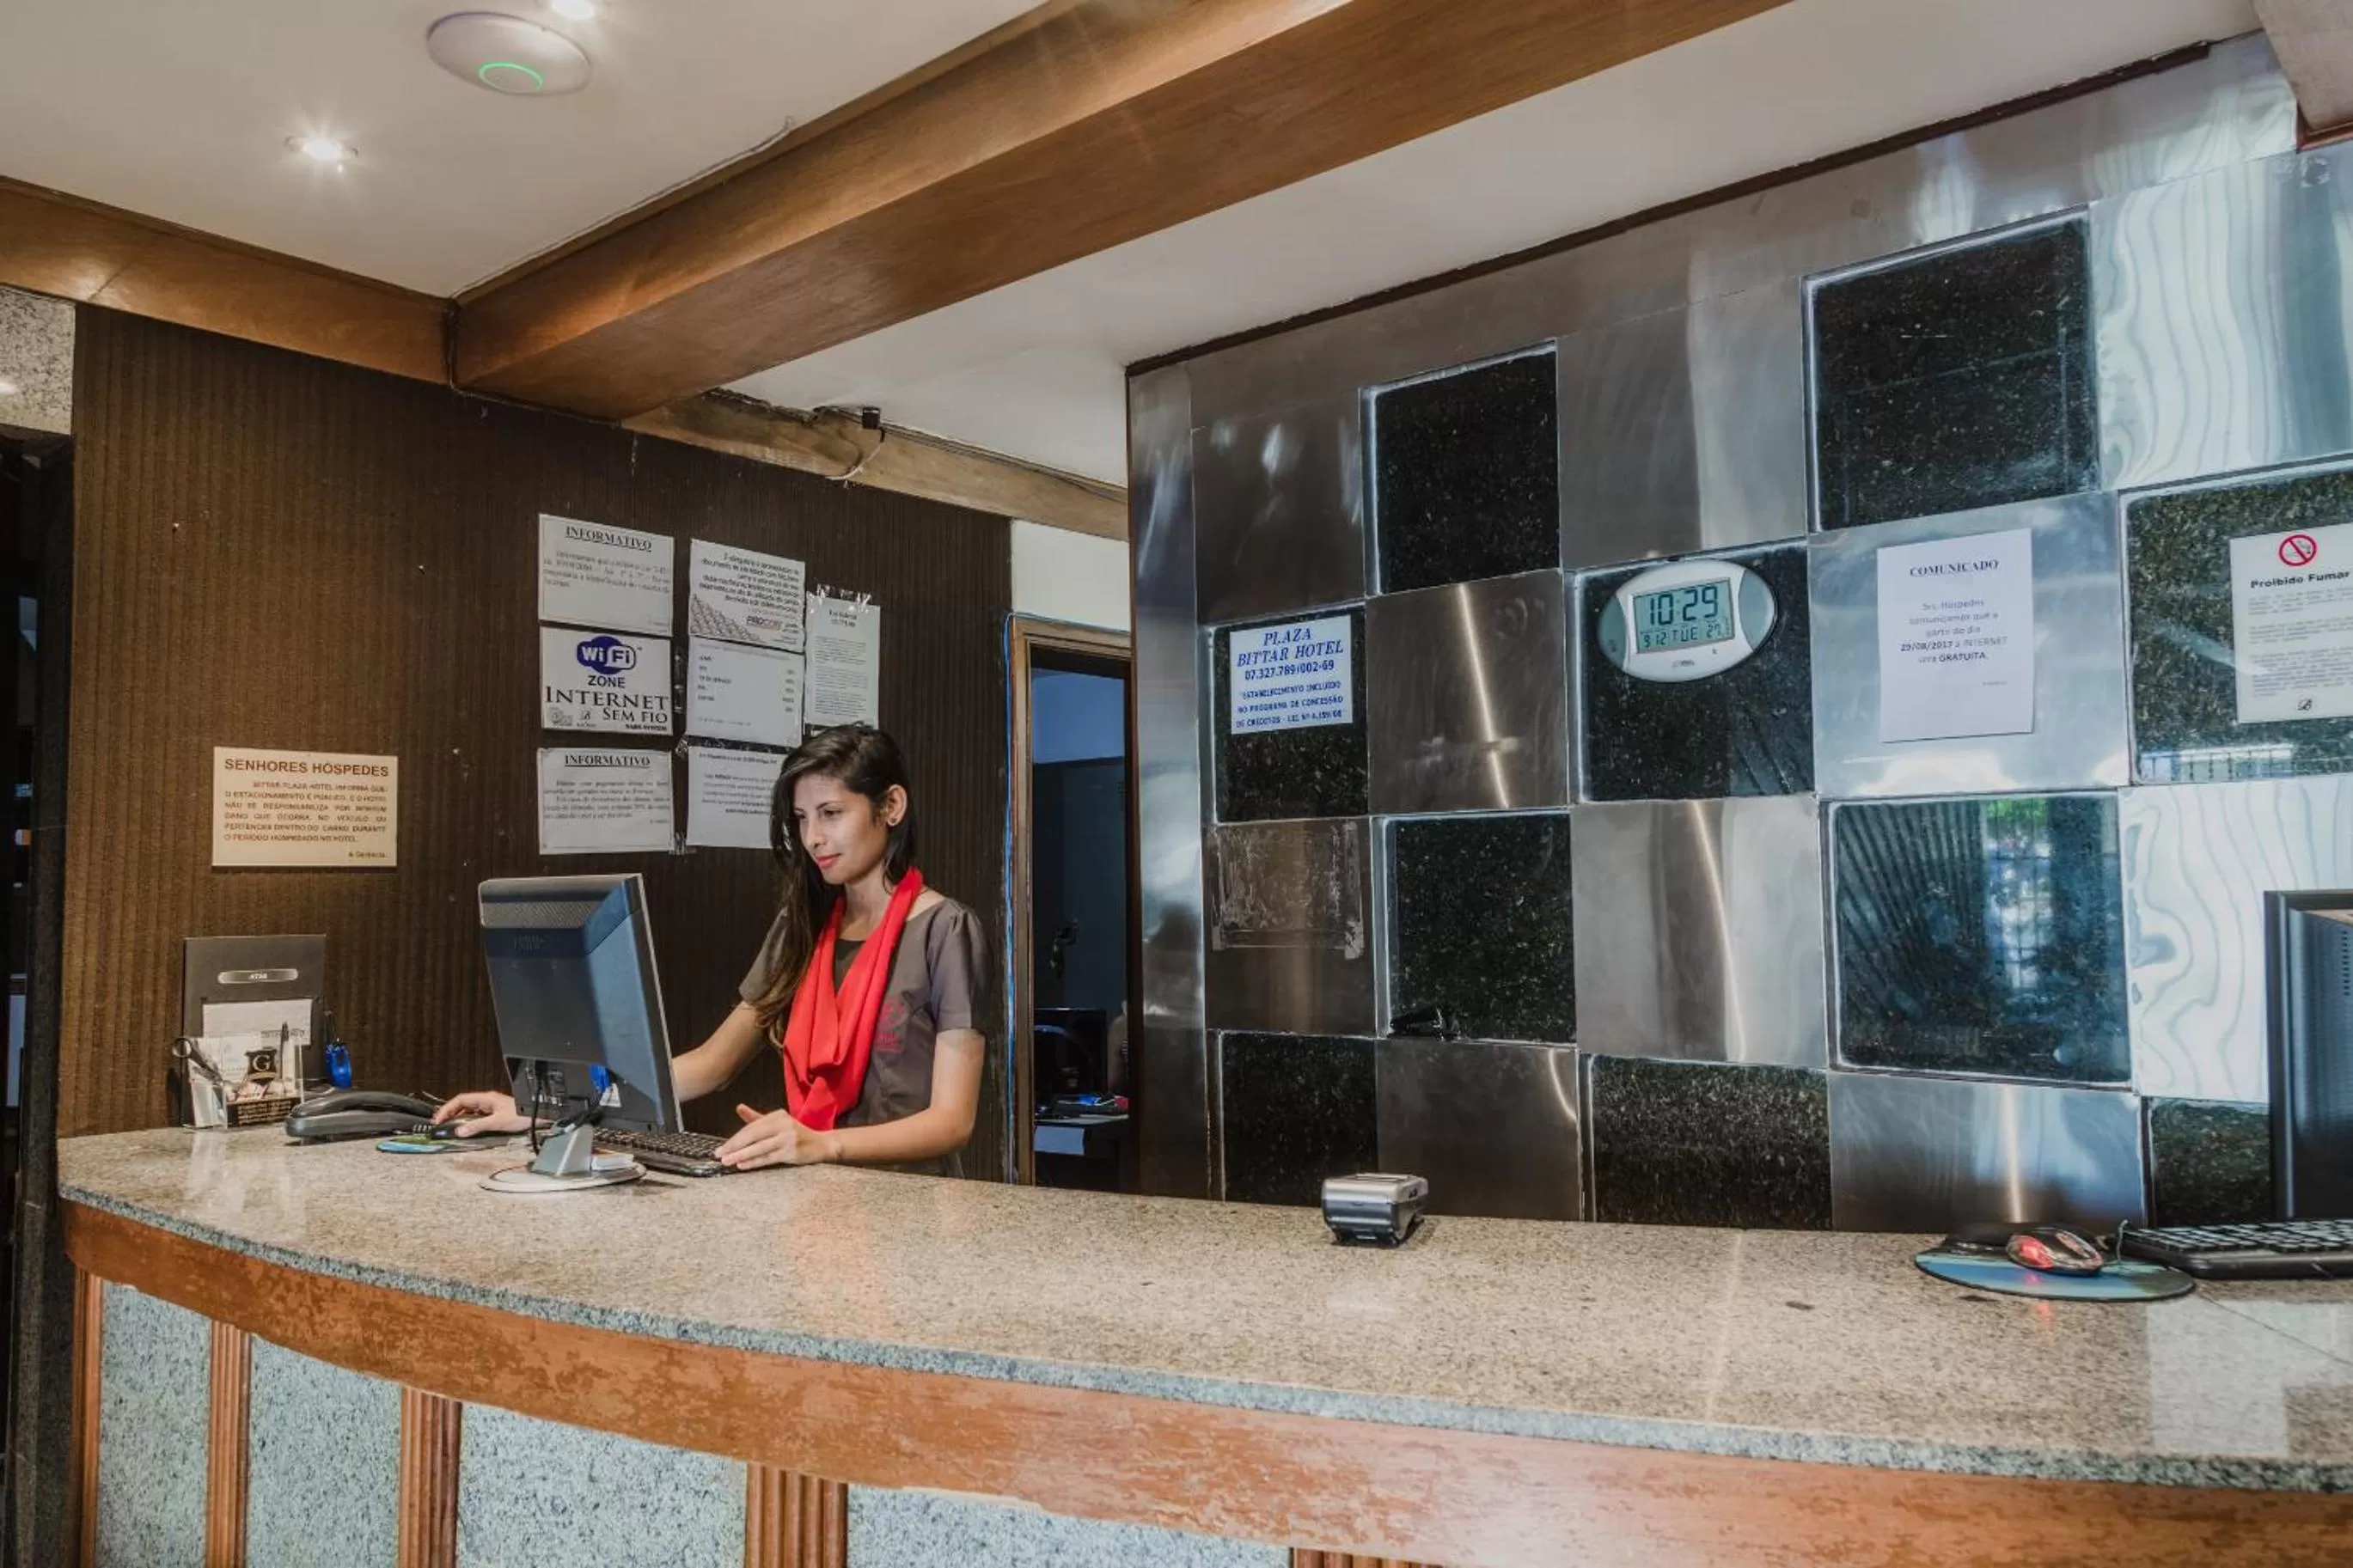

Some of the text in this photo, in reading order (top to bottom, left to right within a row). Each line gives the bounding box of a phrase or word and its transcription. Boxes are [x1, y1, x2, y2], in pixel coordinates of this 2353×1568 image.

[565, 526, 652, 551] INFORMATIVO
[1910, 559, 1999, 577] COMUNICADO
[2250, 570, 2350, 589] Proibido Fumar
[1649, 586, 1718, 625] 10:29
[1264, 628, 1311, 646] PLAZA
[1656, 631, 1666, 645] 12
[1672, 626, 1698, 642] TUE
[1237, 639, 1344, 667] BITTAR HOTEL
[588, 675, 626, 688] ZONE
[546, 686, 669, 711] INTERNET
[602, 707, 634, 722] SEM
[641, 711, 668, 723] FIO
[224, 758, 308, 773] SENHORES
[565, 754, 651, 766] INFORMATIVO
